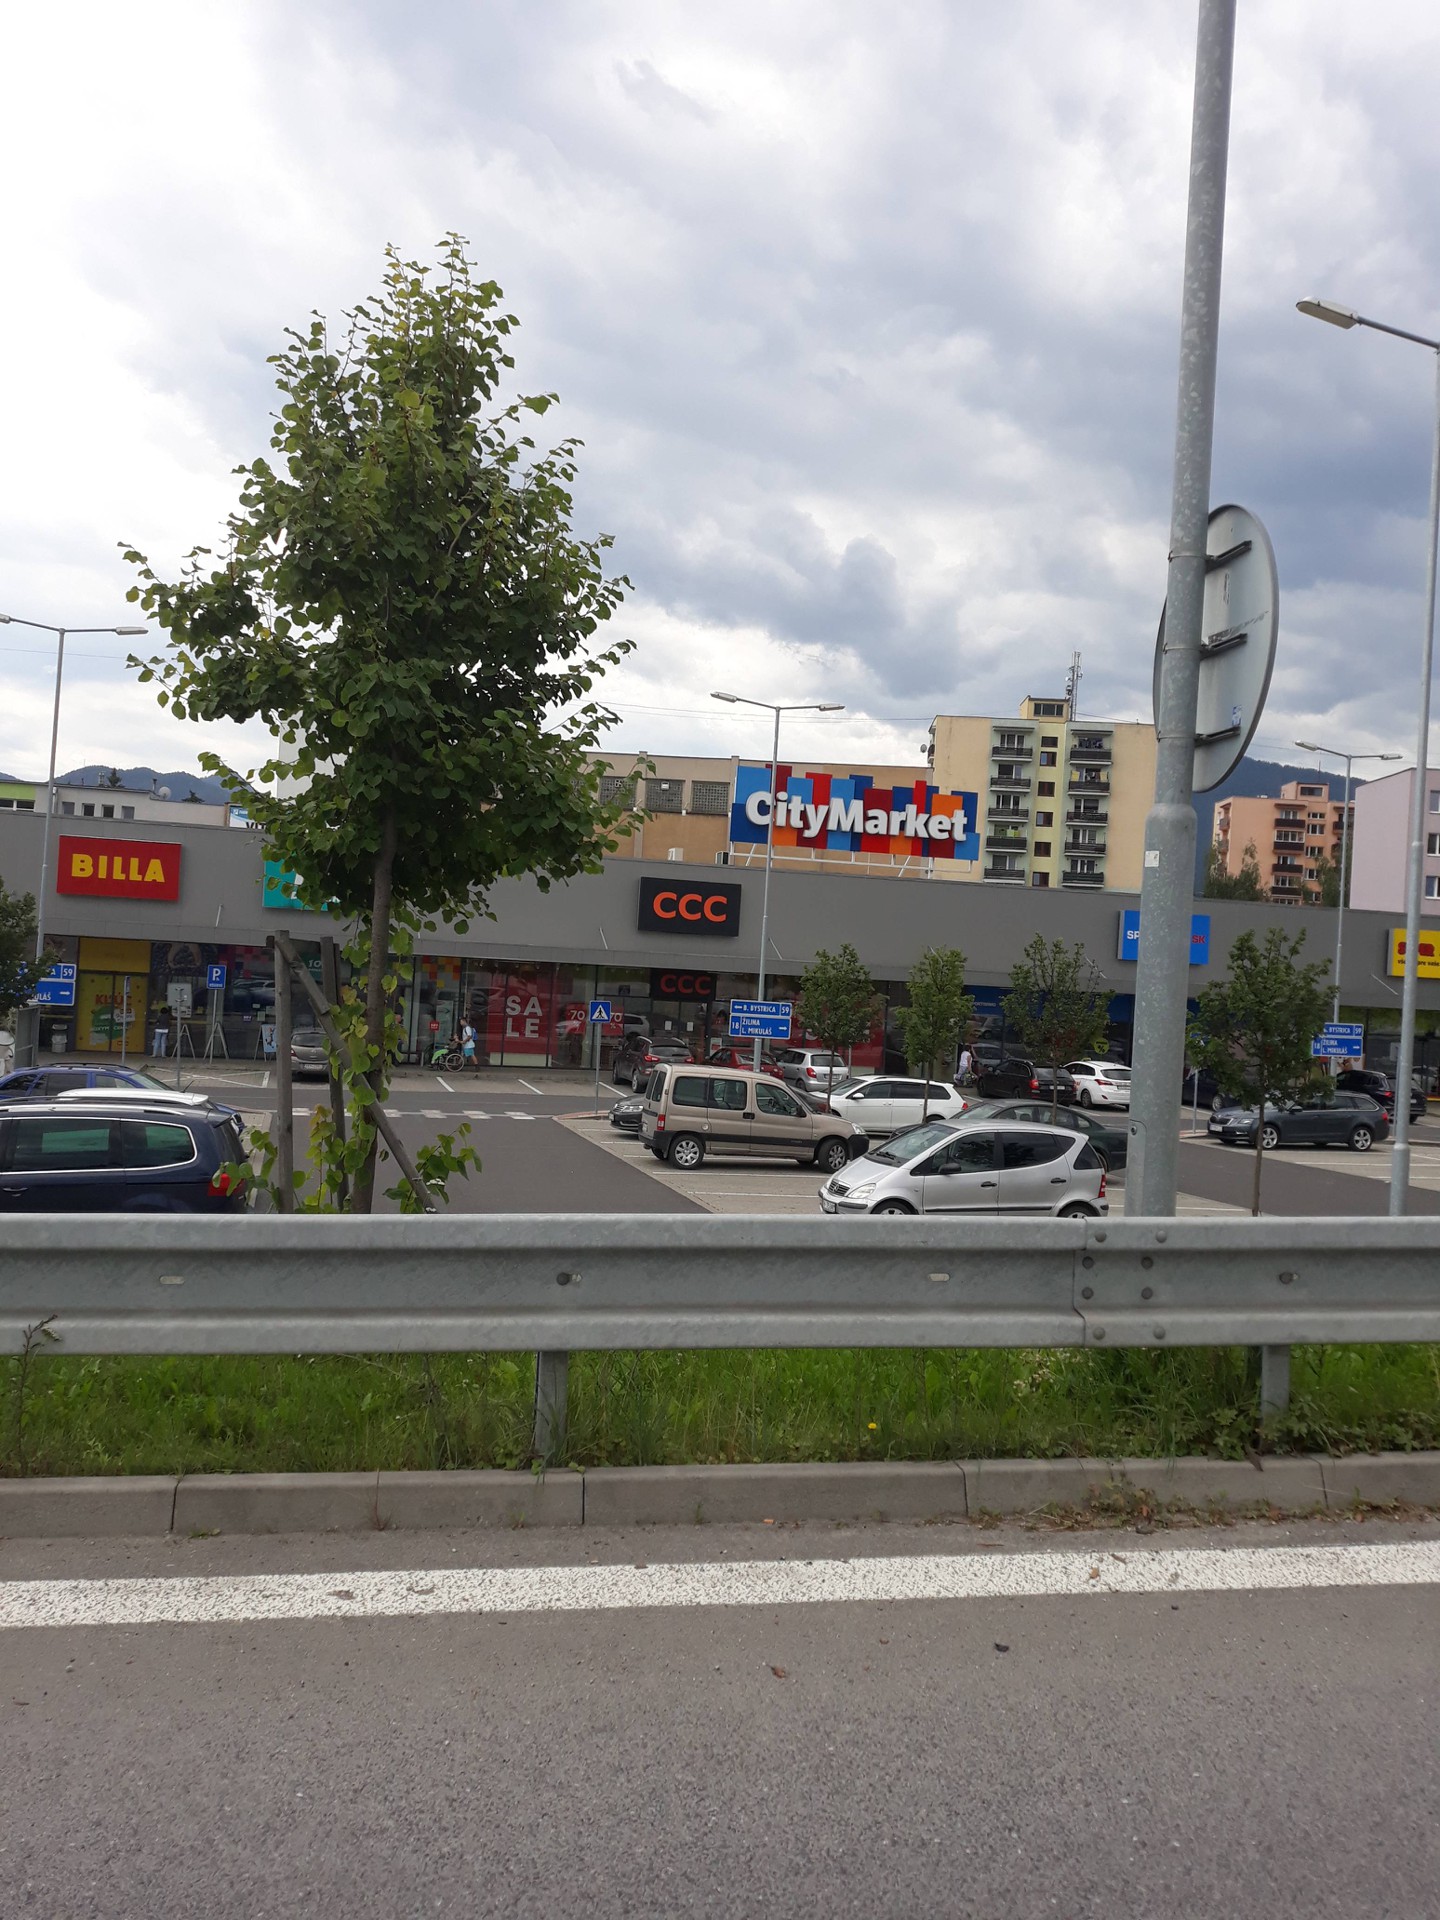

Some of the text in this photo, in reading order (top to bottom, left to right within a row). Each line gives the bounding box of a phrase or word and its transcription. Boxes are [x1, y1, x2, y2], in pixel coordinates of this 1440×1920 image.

[745, 791, 968, 841] CityMarket
[71, 853, 165, 882] BILLA
[653, 891, 728, 922] CCC
[1126, 930, 1206, 944] SP SK
[63, 968, 73, 977] 59
[212, 968, 221, 981] P
[660, 974, 711, 995] CCC
[750, 1005, 776, 1013] BYSTRICA
[732, 1021, 740, 1029] 18
[742, 1017, 760, 1026] ŽILINA
[748, 1027, 772, 1035] MIKULÁŠ
